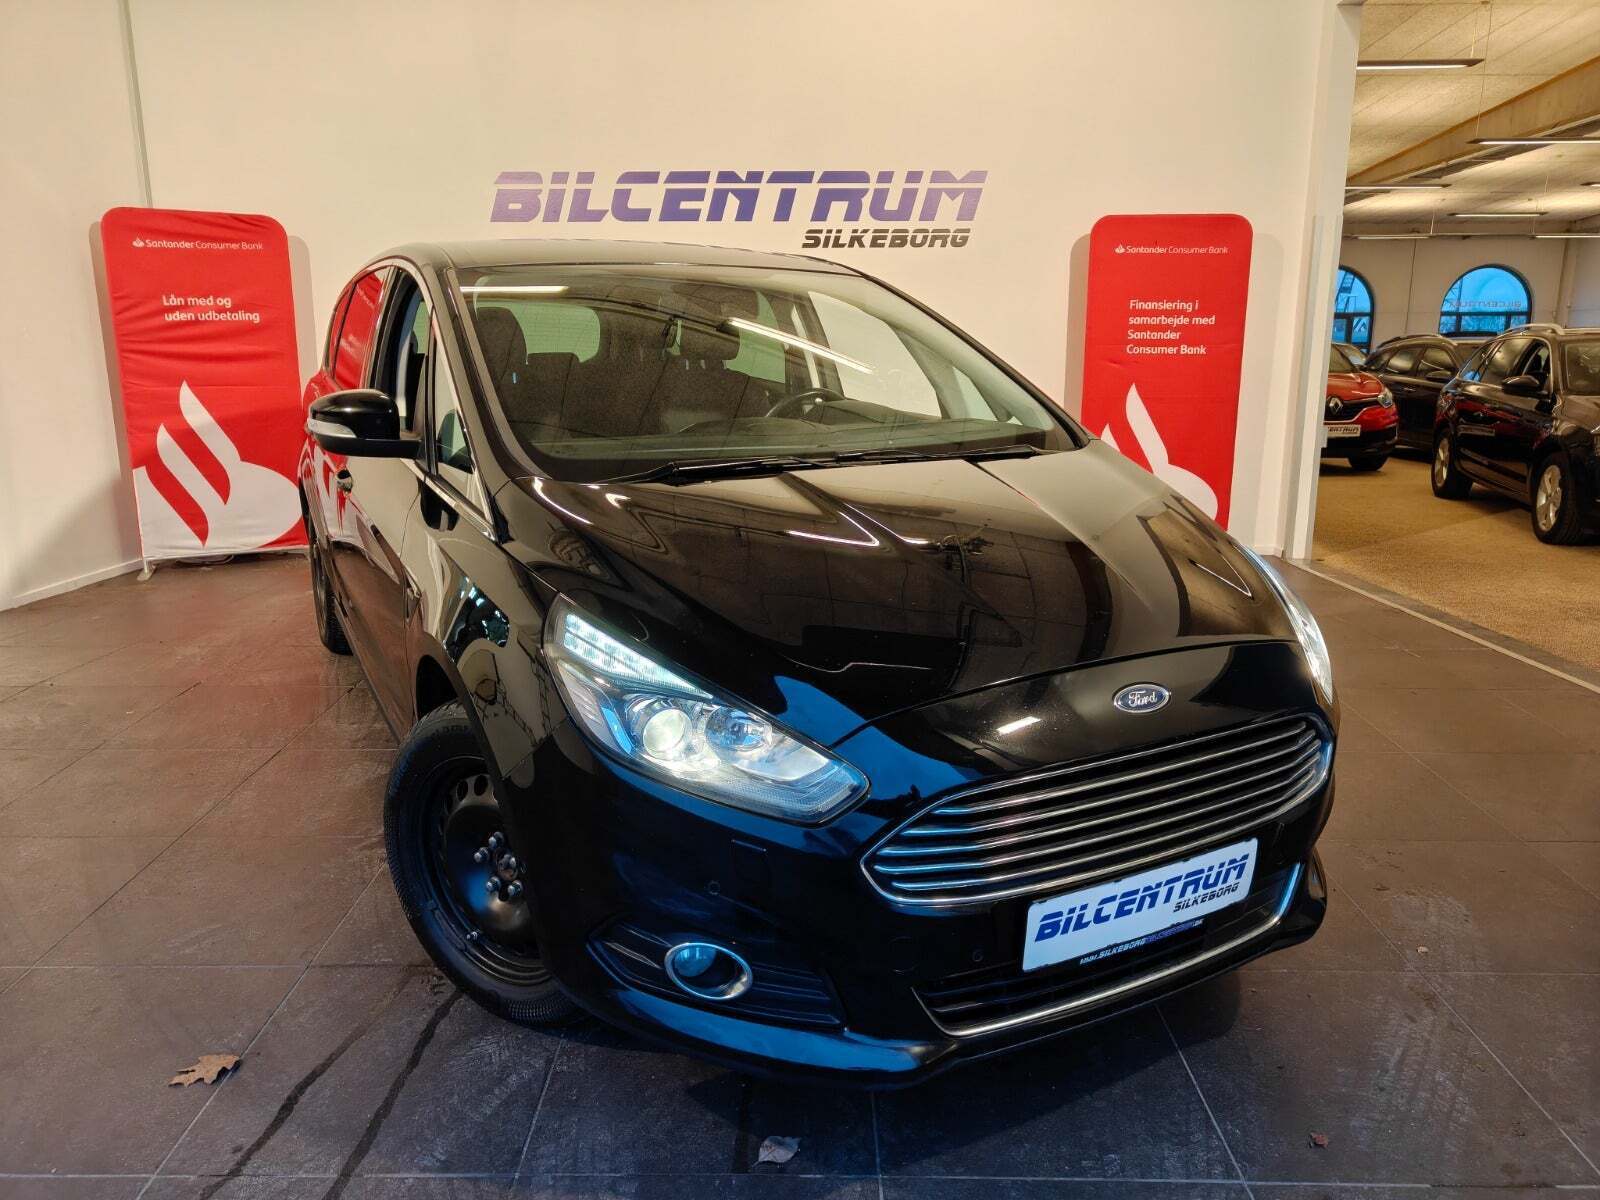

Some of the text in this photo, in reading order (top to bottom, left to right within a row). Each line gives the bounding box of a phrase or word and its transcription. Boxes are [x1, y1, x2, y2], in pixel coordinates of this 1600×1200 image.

[490, 170, 988, 223] BILCENTRUM
[145, 238, 263, 250] Santander Consumer Bank
[802, 228, 971, 248] SILKEBORG
[1126, 245, 1228, 254] Santander Consumer Bank
[163, 294, 232, 308] Lån med og
[1129, 299, 1193, 313] Finansiering
[164, 310, 260, 323] uden udbetaling
[1128, 315, 1216, 328] samarbejde med
[1127, 330, 1181, 340] Santander
[1126, 345, 1207, 355] Consumer Bank
[1128, 689, 1158, 707] Ford
[1035, 853, 1250, 943] BILCENTRUM
